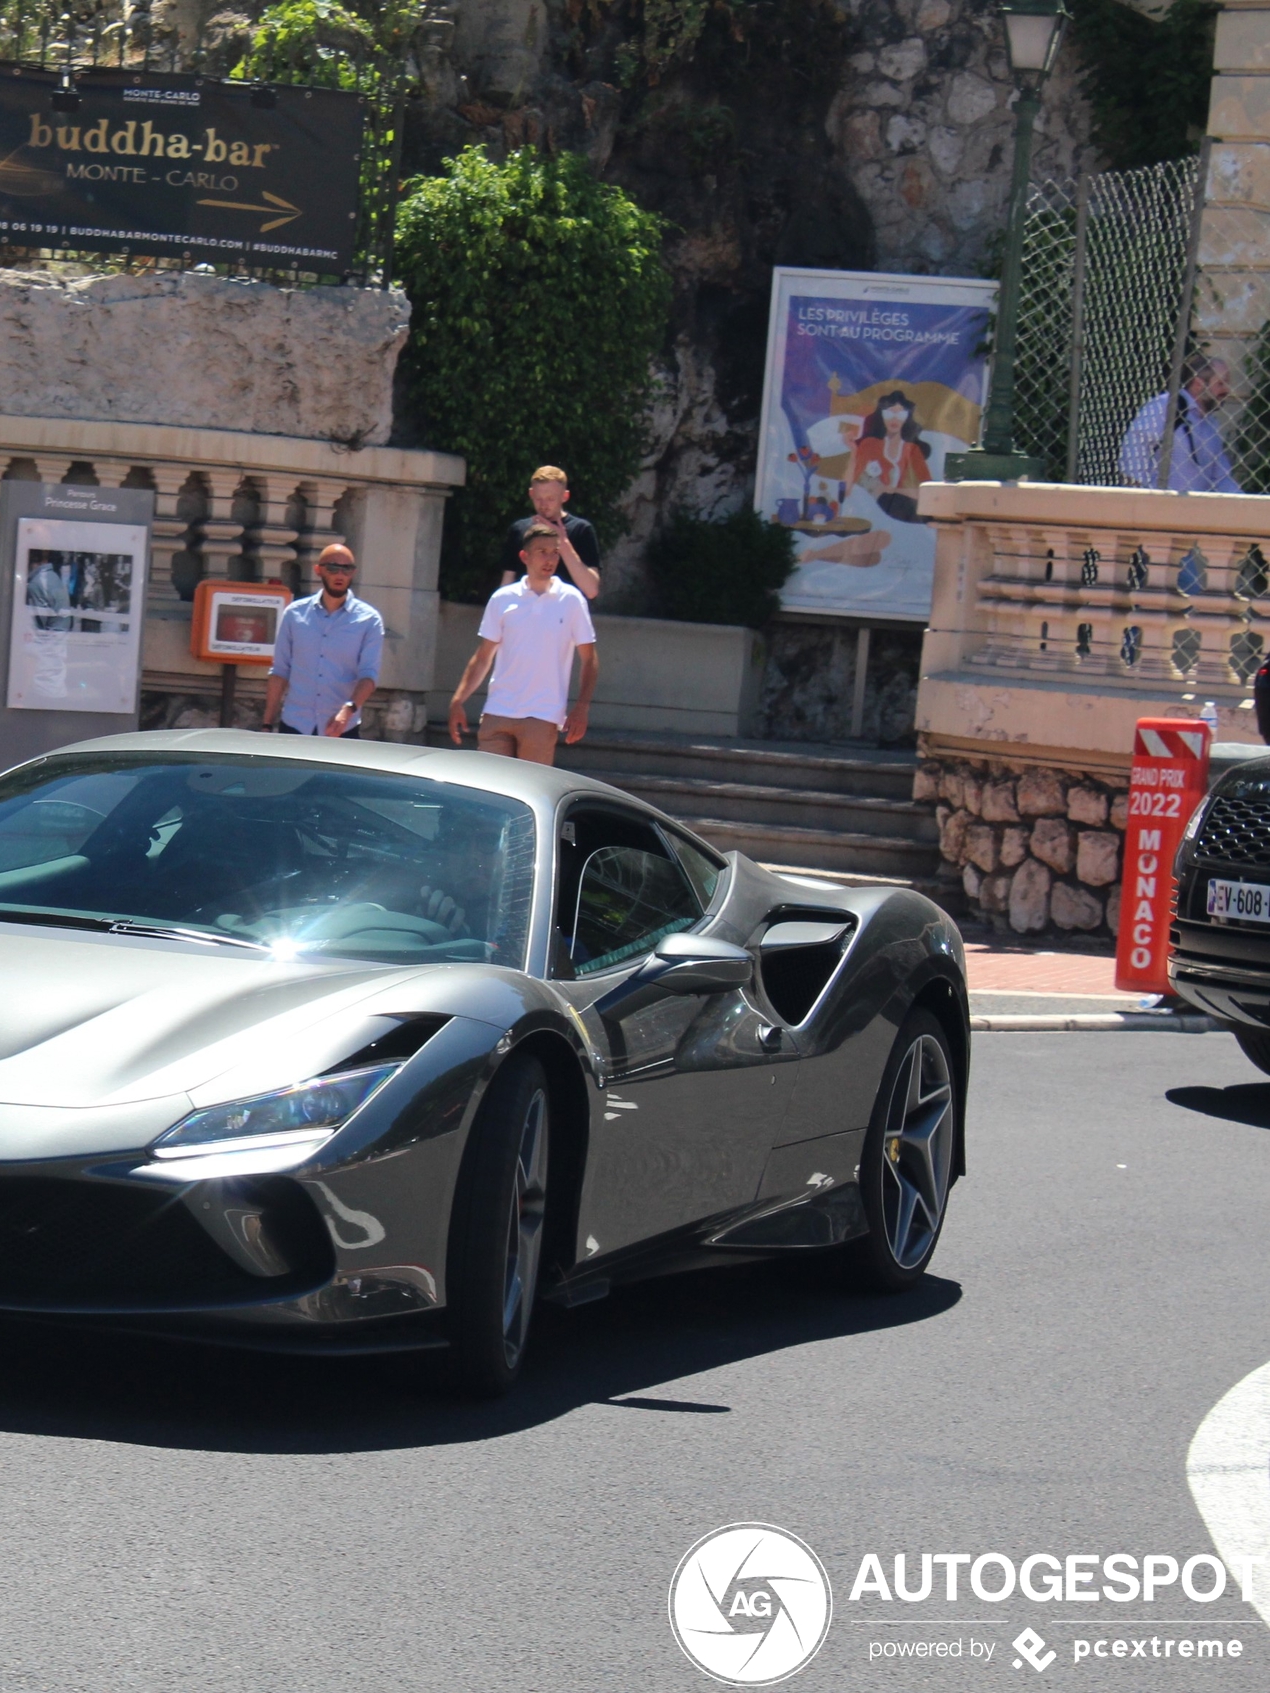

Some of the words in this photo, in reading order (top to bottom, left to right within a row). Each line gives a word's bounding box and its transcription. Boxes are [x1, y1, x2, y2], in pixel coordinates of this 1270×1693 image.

[123, 88, 201, 101] MONTE-CARLO
[28, 113, 272, 168] buddha-bar
[66, 163, 147, 184] MONTE
[166, 170, 239, 192] CARLO
[12, 223, 27, 231] 06
[30, 224, 43, 233] 19
[46, 225, 59, 233] 19
[70, 227, 243, 249] BUDDHABARMONTECARLO.COM
[253, 243, 338, 260] #BUDDHABARMC
[798, 307, 824, 321] LES
[826, 308, 910, 326] PRIVILÈGES
[797, 323, 837, 336] SONT
[840, 326, 861, 339] AU
[863, 327, 961, 345] PROGRAMME
[45, 497, 88, 510] Princesse
[90, 500, 118, 512] Grace
[1131, 767, 1159, 786] GRAND
[1160, 768, 1186, 788] PRIX
[1130, 792, 1181, 818] 2022
[1131, 829, 1162, 969] MONACO
[1217, 886, 1270, 918] EV-608-
